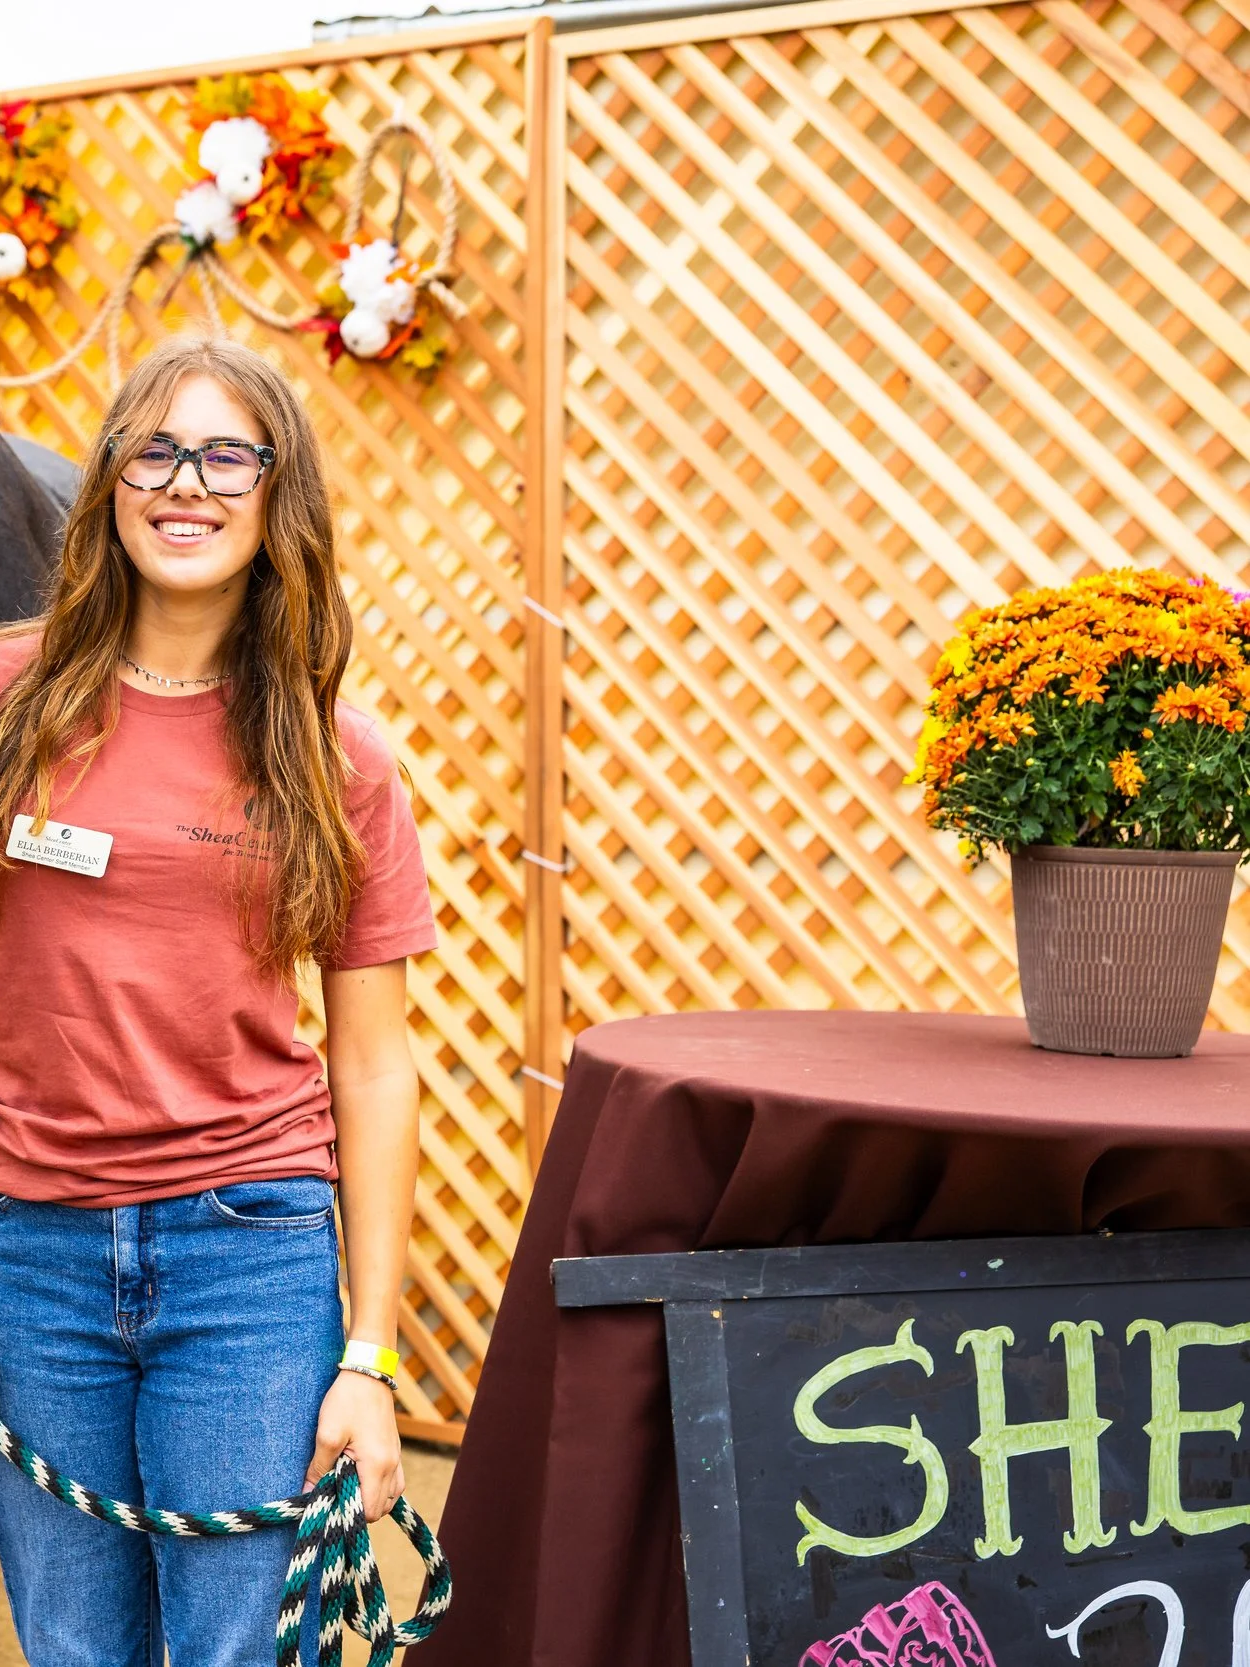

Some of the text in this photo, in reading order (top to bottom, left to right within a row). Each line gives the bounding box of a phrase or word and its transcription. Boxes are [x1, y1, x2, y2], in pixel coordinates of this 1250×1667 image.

[176, 824, 191, 833] The
[16, 840, 42, 853] ELLA
[43, 845, 100, 865] BERBERIAN
[21, 850, 36, 859] Shea
[36, 853, 55, 863] Center
[68, 861, 91, 871] Member
[793, 1318, 1250, 1567] SHE
